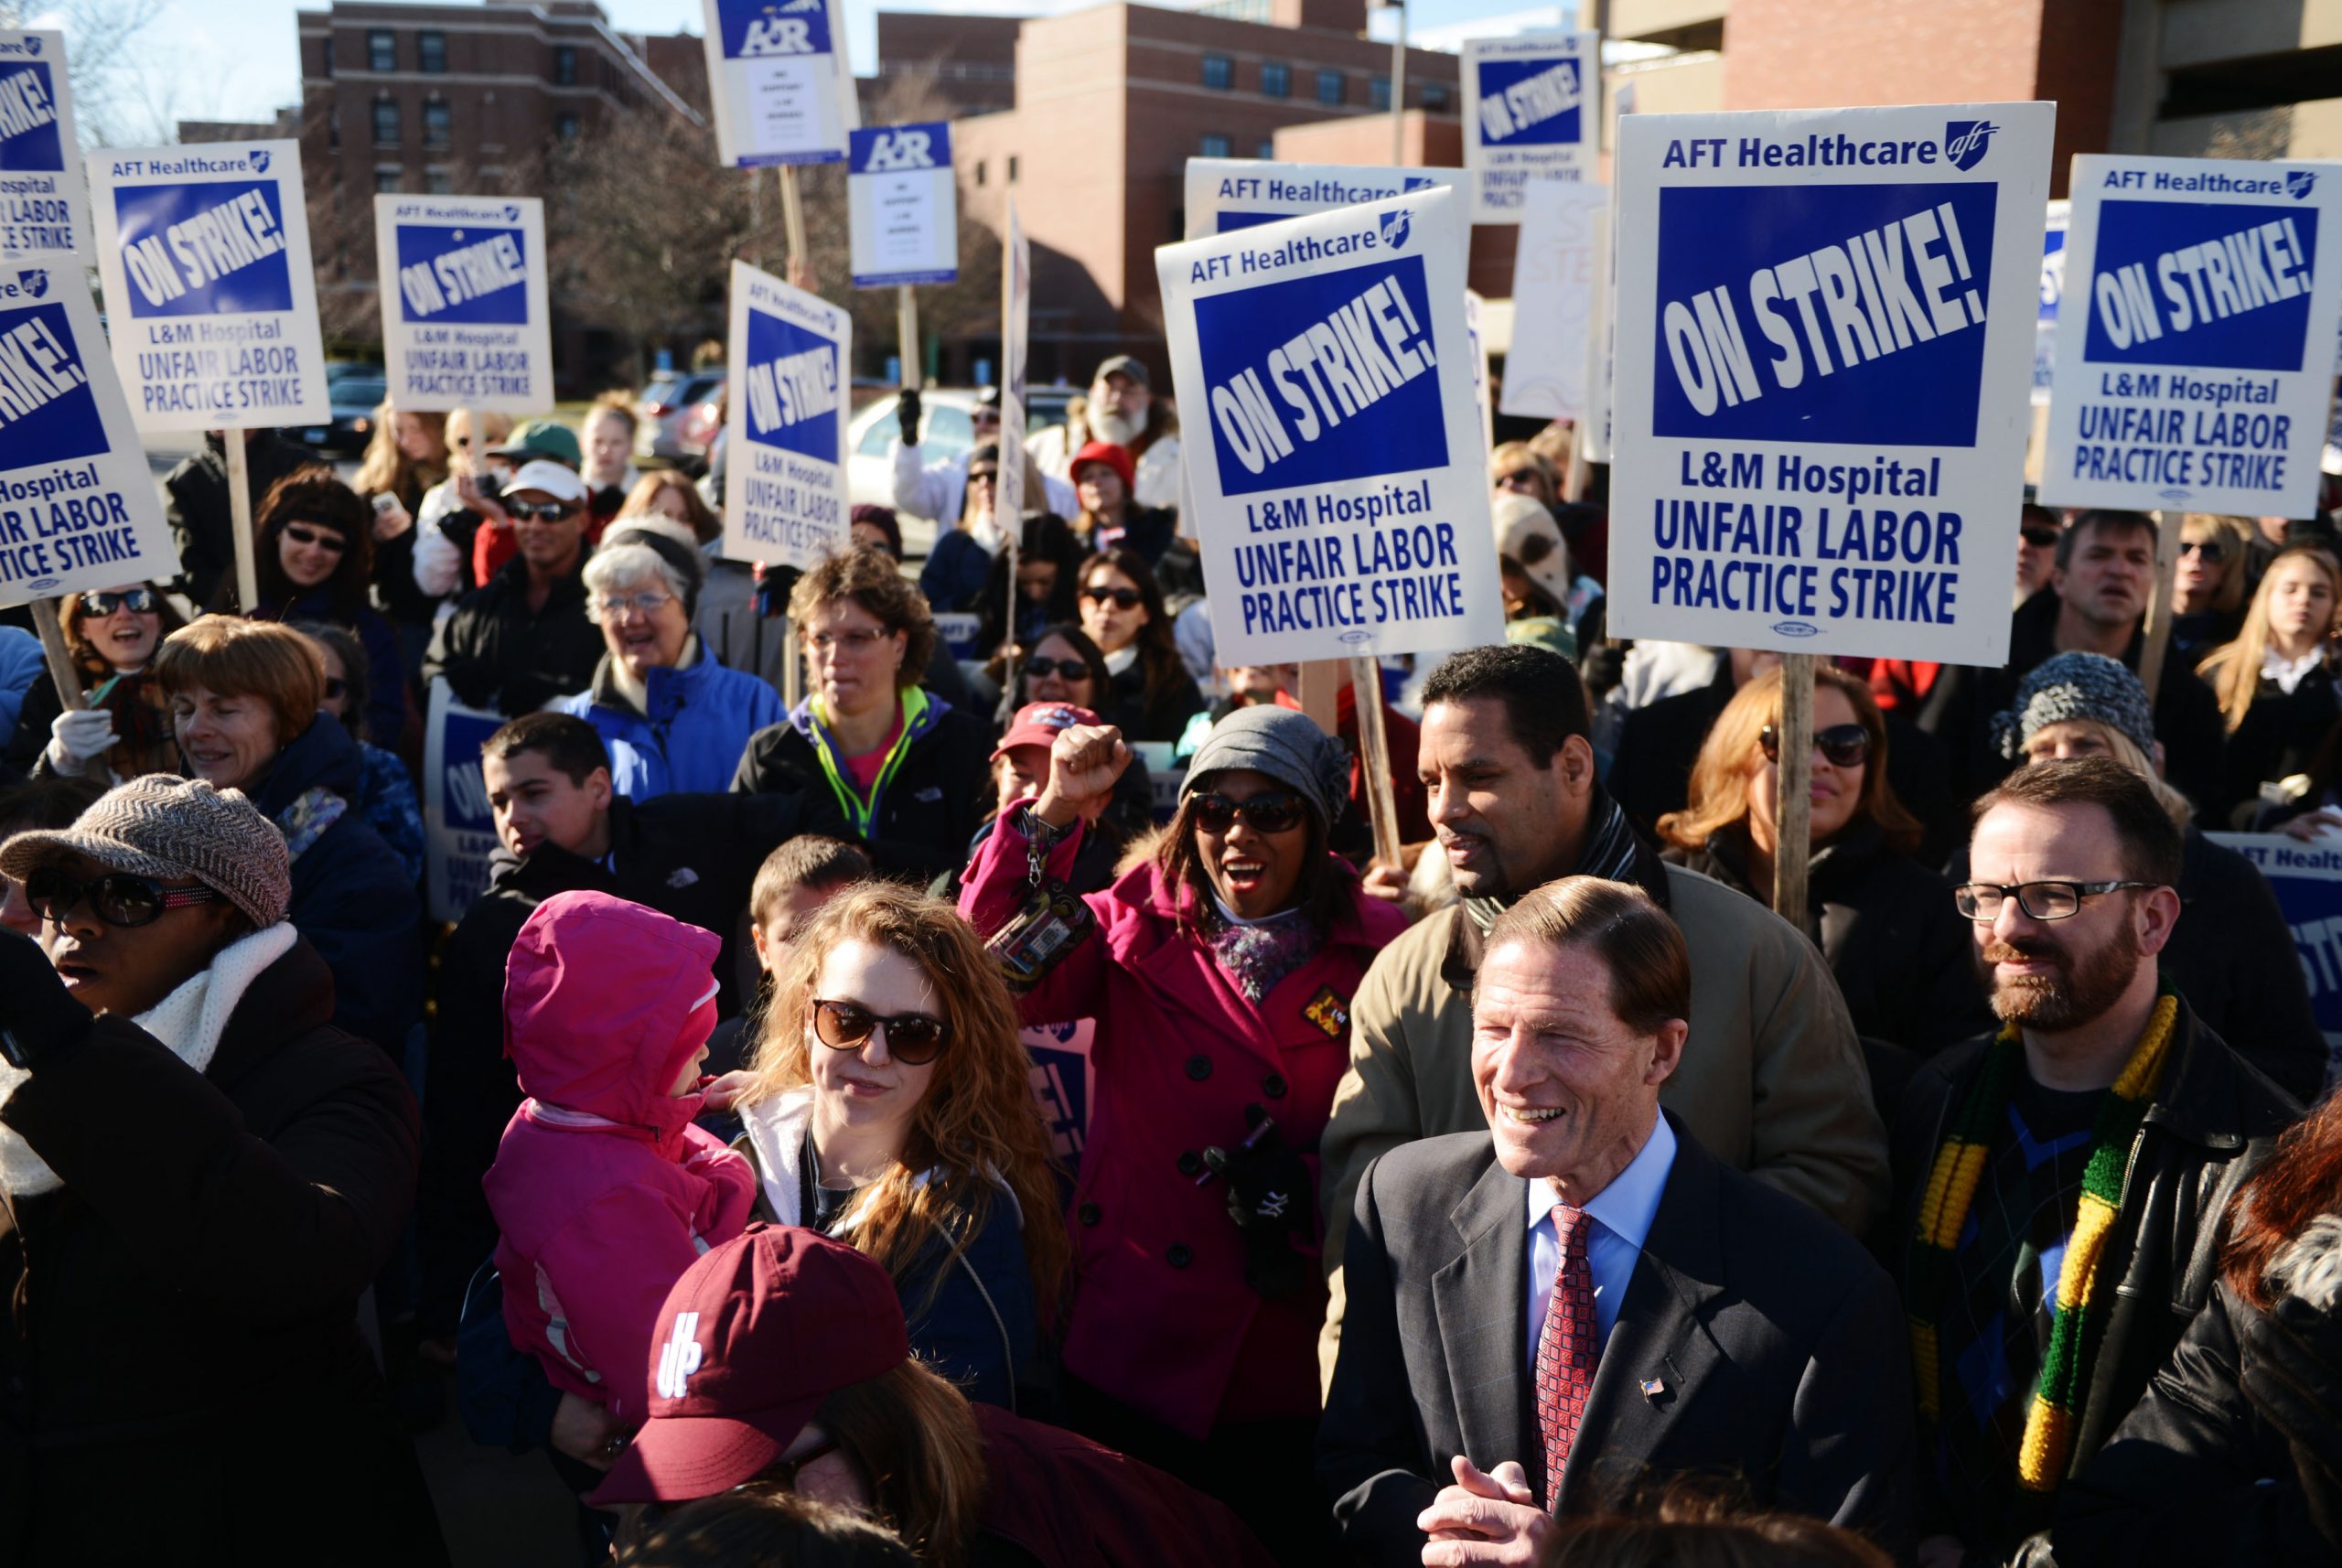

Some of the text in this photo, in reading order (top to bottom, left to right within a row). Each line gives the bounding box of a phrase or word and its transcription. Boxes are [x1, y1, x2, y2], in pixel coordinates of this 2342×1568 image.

[1481, 91, 1516, 142] ON
[112, 157, 247, 177] AFT Healthcare
[1662, 138, 1728, 169] AFT
[1737, 133, 1938, 167] Healthcare
[1219, 178, 1262, 199] AFT
[1269, 179, 1399, 203] Healthcare
[2102, 170, 2147, 188] AFT
[2154, 171, 2283, 195] Healthcare
[9, 199, 70, 223] LABOR
[22, 226, 75, 249] STRIKE
[123, 188, 286, 307] ON STRIKE!
[1191, 254, 1232, 285] AFT
[1241, 230, 1377, 274] Healthcare
[400, 231, 528, 317] ON STRIKE!
[2095, 262, 2164, 350] ON
[2156, 217, 2313, 332] STRIKE!
[149, 318, 282, 345] L&M Hospital
[1663, 201, 1986, 416] ON STRIKE!
[138, 347, 299, 381] UNFAIR LABOR
[405, 349, 531, 371] UNFAIR LABOR
[1211, 274, 1437, 475] ON STRIKE!
[143, 378, 304, 413] PRACTICE STRIKE
[407, 373, 532, 397] PRACTICE STRIKE
[747, 362, 783, 435] ON
[2101, 372, 2279, 408] L&M Hospital
[2079, 405, 2186, 445] UNFAIR
[2195, 411, 2291, 450] LABOR
[755, 451, 783, 474] L&M
[1681, 450, 1940, 504] L&M Hospital
[2074, 445, 2287, 491] PRACTICE STRIKE
[30, 492, 130, 539] LABOR
[746, 477, 839, 525] UNFAIR LABOR
[1246, 478, 1432, 533] L&M Hospital
[52, 527, 142, 572] STRIKE
[744, 510, 801, 548] PRACTICE
[1654, 499, 1962, 565] UNFAIR LABOR
[1234, 522, 1458, 588] UNFAIR LABOR
[1241, 572, 1465, 636] PRACTICE STRIKE
[1651, 555, 1959, 625] PRACTICE STRIKE
